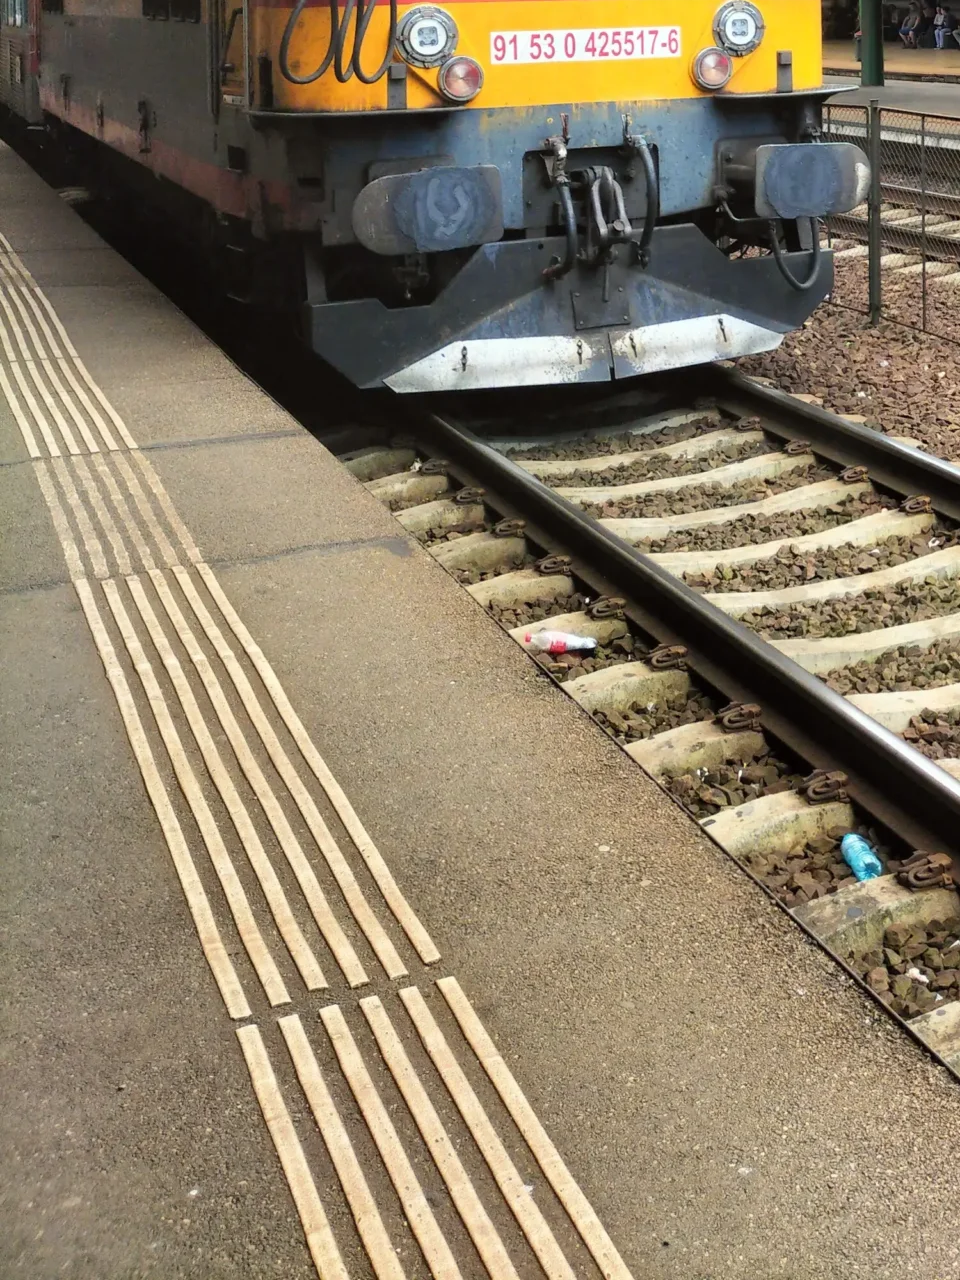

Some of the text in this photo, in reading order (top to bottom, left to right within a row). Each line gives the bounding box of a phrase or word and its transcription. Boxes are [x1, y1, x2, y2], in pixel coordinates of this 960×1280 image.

[493, 29, 679, 61] 91 53 0 425517-6
